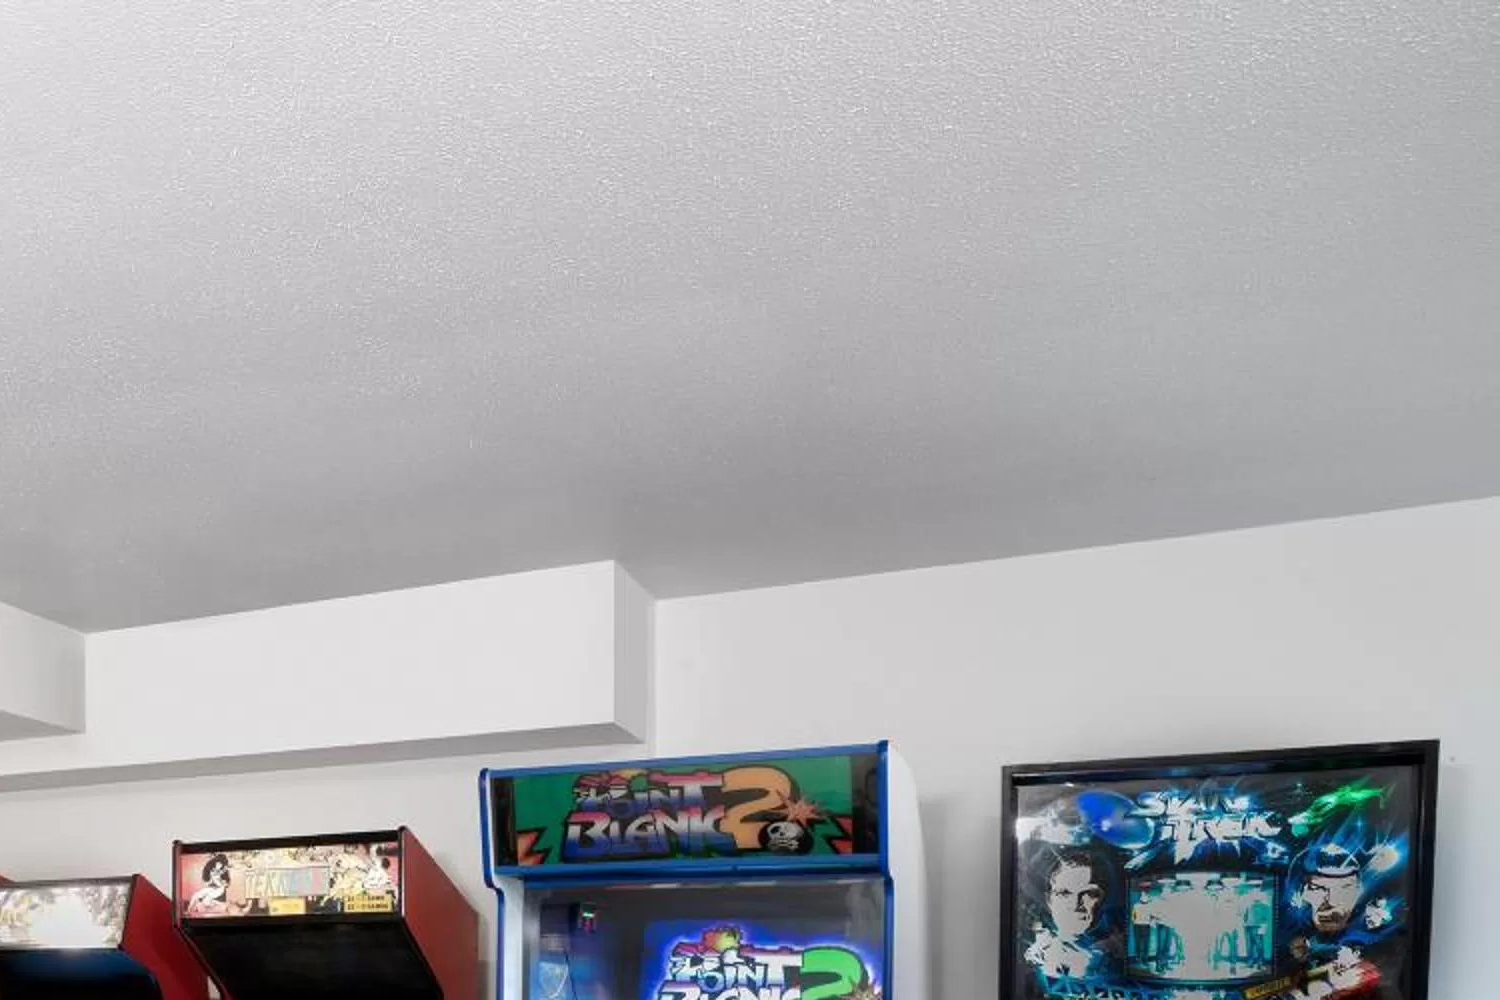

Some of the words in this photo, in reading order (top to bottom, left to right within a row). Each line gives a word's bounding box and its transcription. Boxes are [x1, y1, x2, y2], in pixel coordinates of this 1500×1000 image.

[566, 808, 730, 858] BLANK
[721, 766, 791, 849] 2
[573, 771, 725, 814] POINT
[670, 946, 804, 992] POINT
